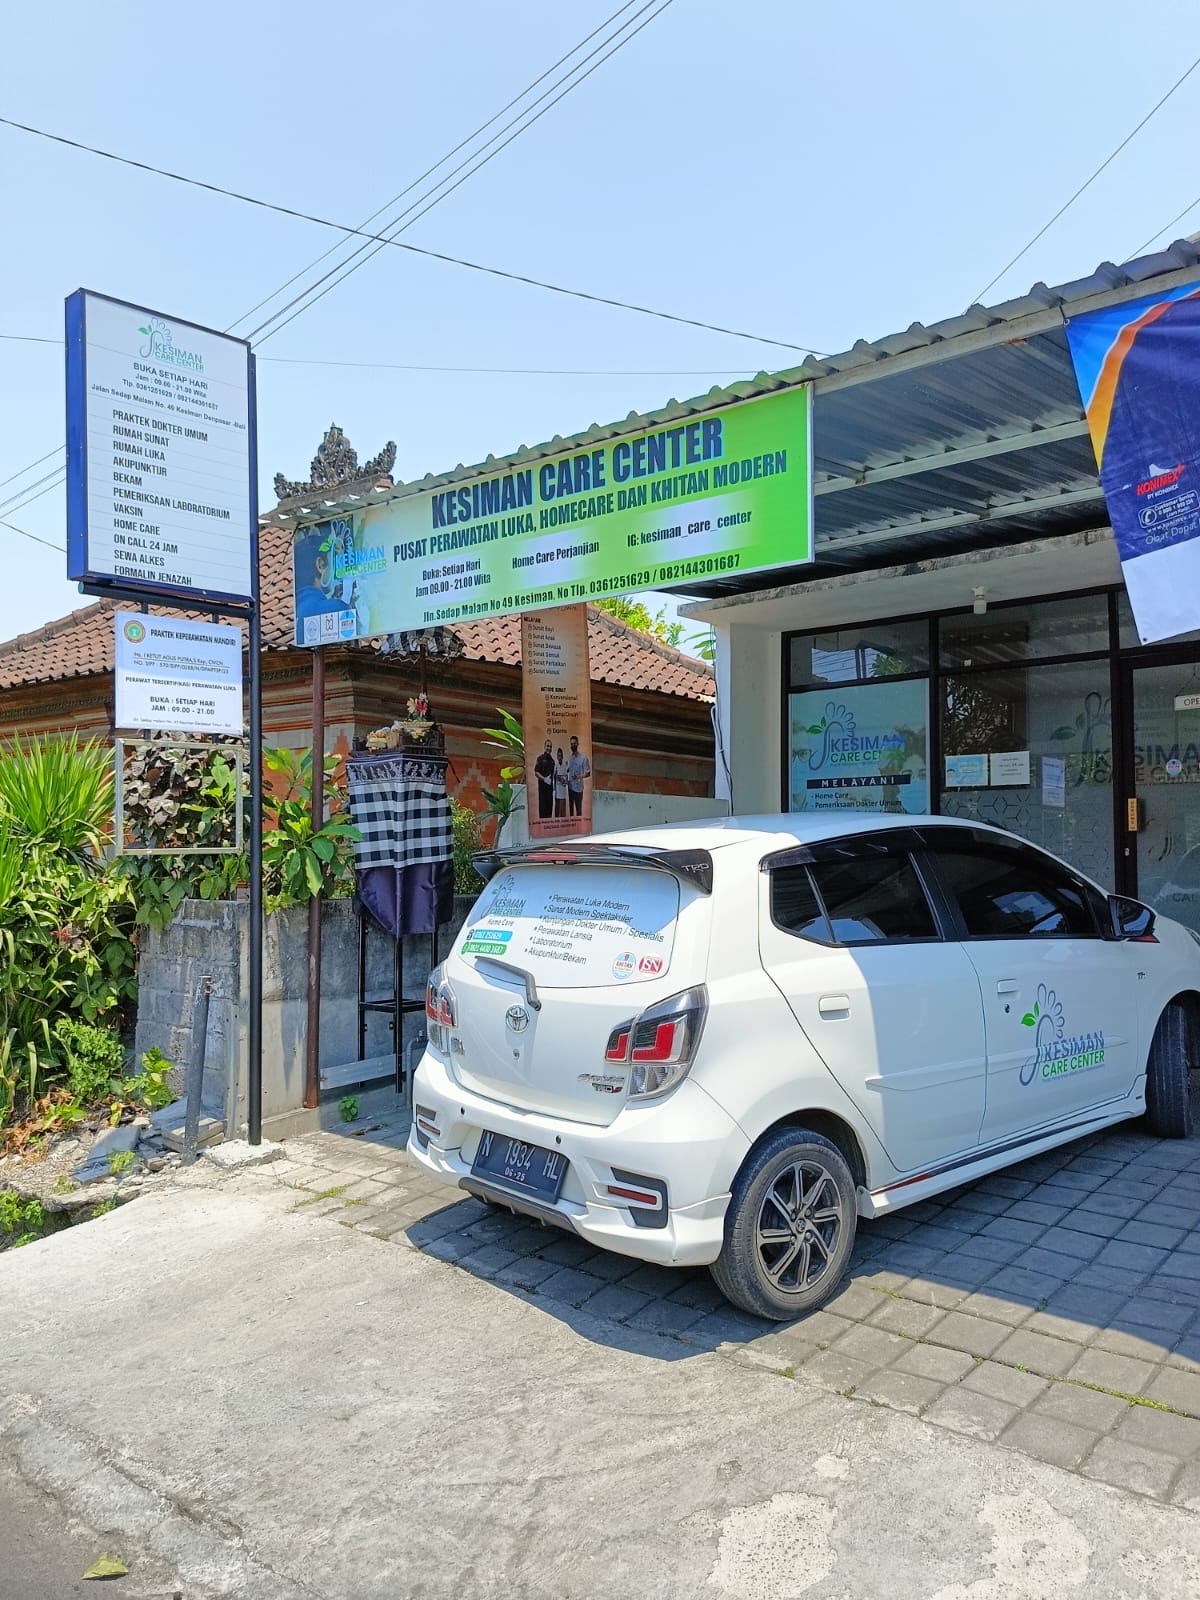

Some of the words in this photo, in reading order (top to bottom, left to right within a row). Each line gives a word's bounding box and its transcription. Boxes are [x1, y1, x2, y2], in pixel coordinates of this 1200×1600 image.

[155, 352, 175, 361] CARE
[156, 342, 202, 363] KESIMAN
[134, 362, 157, 375] BUKA
[159, 370, 187, 383] SETIAP
[189, 378, 208, 390] HARI
[136, 373, 149, 382] Jam
[92, 384, 109, 393] Jalan
[111, 388, 131, 400] Sedap
[133, 394, 154, 405] Malam
[176, 406, 202, 418] Kesiman
[204, 413, 231, 425] Denpasar
[112, 409, 150, 426] PRAKTEK
[152, 420, 182, 435] DOKTER
[184, 429, 208, 441] UMUM
[113, 425, 142, 440] RUMAH
[144, 434, 169, 447] SUNAT
[113, 441, 143, 456] RUMAH
[145, 448, 165, 461] LUKA
[113, 456, 167, 476] AKUPUNKTUR
[432, 469, 533, 529] KESIMAN
[540, 449, 606, 501] CARE
[612, 417, 722, 483] CENTER
[113, 472, 142, 486] BEKAM
[1136, 470, 1180, 496] KONIMEX
[113, 487, 170, 508] PEMERIKSAAN
[172, 500, 230, 519] LABORATORIUM
[114, 503, 143, 517] VAKSIN
[393, 538, 427, 562] PUSAT
[430, 521, 498, 554] PERAWATAN
[502, 513, 536, 538] LUKA,
[540, 493, 613, 529] HOMECARE
[618, 484, 647, 511] DAN
[651, 469, 709, 503] KHITAN
[714, 450, 787, 489] MODERN
[114, 518, 138, 531] HOME
[139, 523, 160, 536] CARE
[627, 534, 639, 548] IG:
[640, 510, 752, 545] kesiman_care_center
[114, 534, 126, 545] ON
[128, 537, 147, 549] CALL
[150, 541, 160, 550] 24
[162, 542, 178, 553] JAM
[114, 550, 138, 563] SEWA
[139, 553, 165, 567] ALKES
[336, 545, 385, 568] KESIMAN
[512, 556, 534, 569] Home
[535, 551, 555, 564] Care
[556, 541, 600, 560] Perjanjian
[114, 565, 156, 580] FORMALIN
[158, 570, 192, 586] JENAZAH
[423, 568, 442, 581] Buka:
[442, 562, 465, 577] Setiap
[466, 558, 481, 572] Hari
[416, 586, 428, 597] Jam
[430, 581, 450, 595] 09.00
[454, 576, 473, 591] 21.00
[474, 574, 491, 586] Wita
[462, 601, 488, 615] Malam
[490, 600, 500, 610] No
[502, 597, 513, 608] 49
[557, 588, 568, 600] No
[571, 584, 588, 596] Tlp.
[590, 571, 650, 593] 0361251629
[653, 569, 657, 582] /
[659, 554, 740, 581] 082144301687
[150, 628, 174, 639] PRAKTEK
[176, 631, 212, 643] KEPERAWATAN
[214, 636, 236, 646] MANDIRI
[126, 676, 150, 684] PERAWAT
[152, 679, 190, 687] TERSERTIFIKASI
[192, 682, 222, 690] PERAWATAN
[150, 696, 170, 704] BUKA
[831, 752, 860, 762] CARE
[821, 776, 894, 787] MELAYANI
[496, 899, 527, 908] KESIMAN
[552, 894, 584, 905] Perawatan
[585, 898, 601, 906] Luka
[602, 900, 630, 911] Modern
[547, 905, 565, 913] Sunat
[566, 907, 592, 917] Modern
[591, 909, 634, 923] Spektakuler
[537, 925, 570, 937] Perawatan
[570, 930, 593, 941] Lansia
[542, 916, 574, 926] Kunjungan
[575, 919, 598, 929] Dokter
[599, 922, 623, 934] Umum
[628, 928, 664, 942] Spesialis
[533, 936, 572, 949] Laboratorium
[1044, 1030, 1104, 1062] KESIMAN
[1042, 1058, 1068, 1077] CARE
[1071, 1050, 1104, 1070] CENTER
[482, 1132, 494, 1156] N
[505, 1140, 536, 1170] 1934
[543, 1152, 559, 1180] HL
